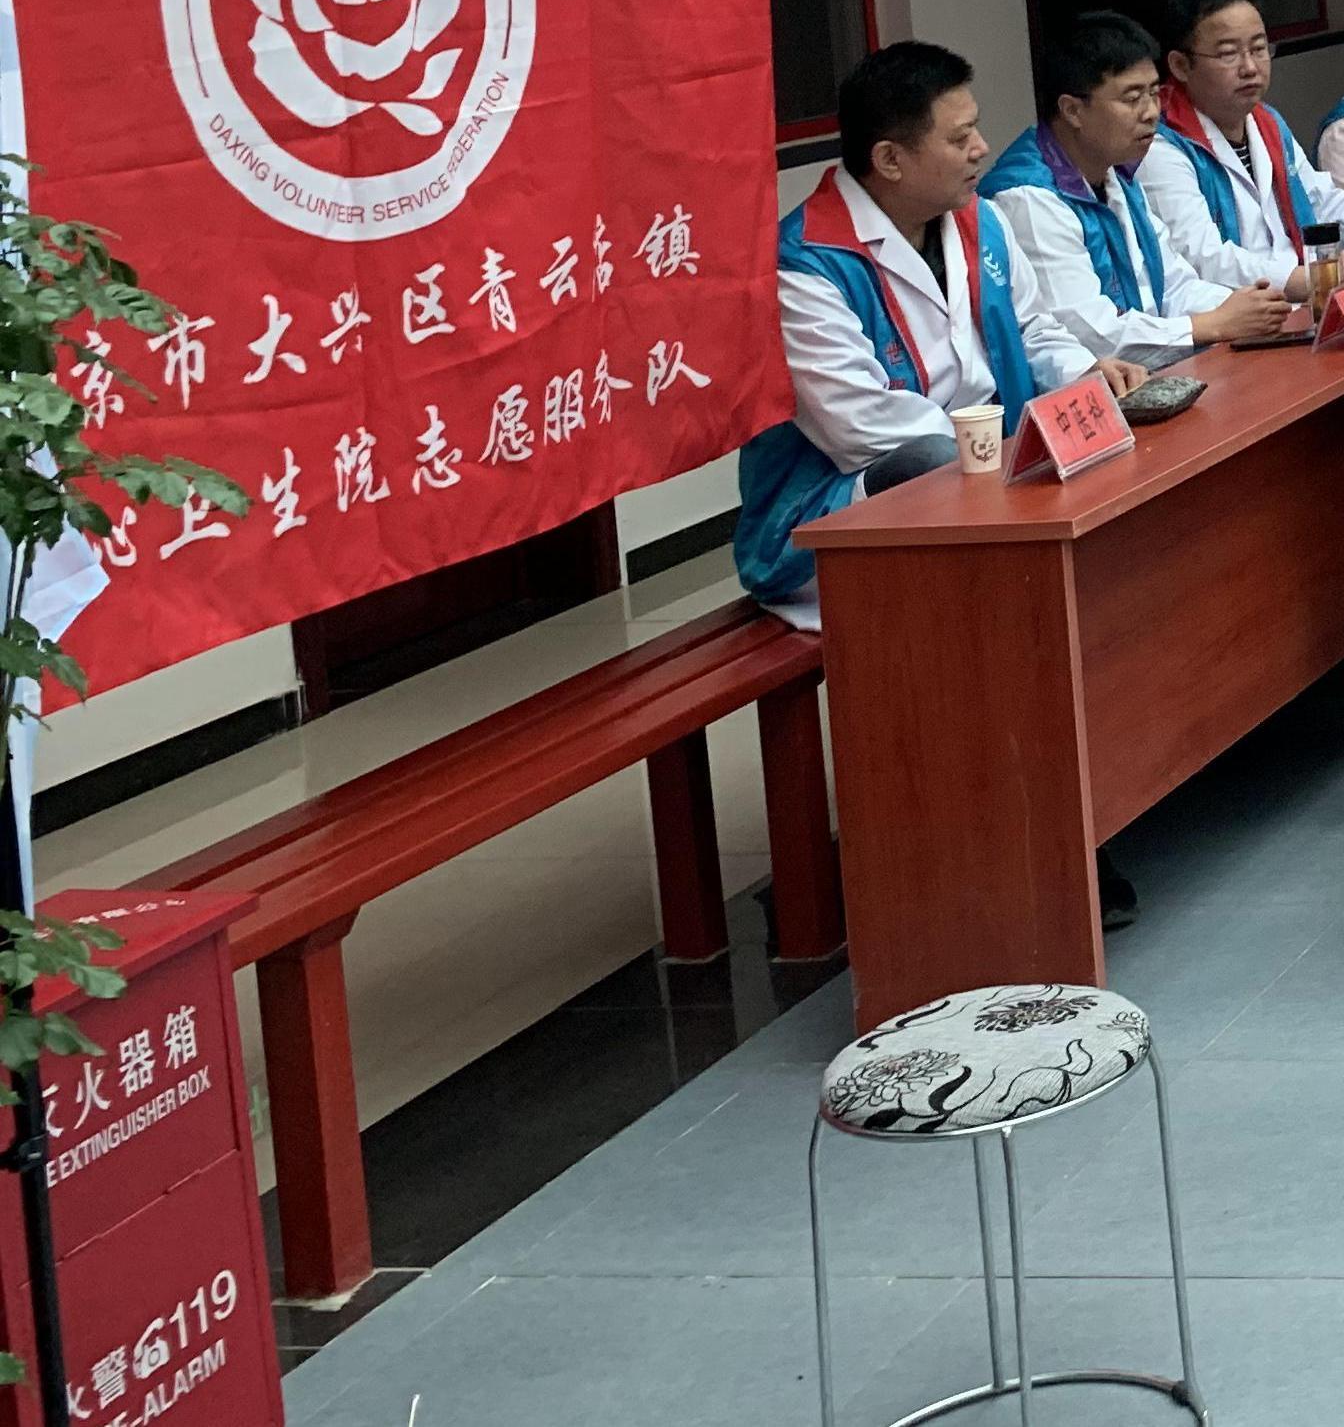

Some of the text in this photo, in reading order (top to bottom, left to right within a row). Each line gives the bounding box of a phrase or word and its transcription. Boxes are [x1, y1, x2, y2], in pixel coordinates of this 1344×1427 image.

[209, 112, 270, 181] DAXING
[373, 172, 451, 223] SERVICE
[58, 1087, 178, 1181] EXTINGUISHER
[177, 1065, 212, 1106] BOX
